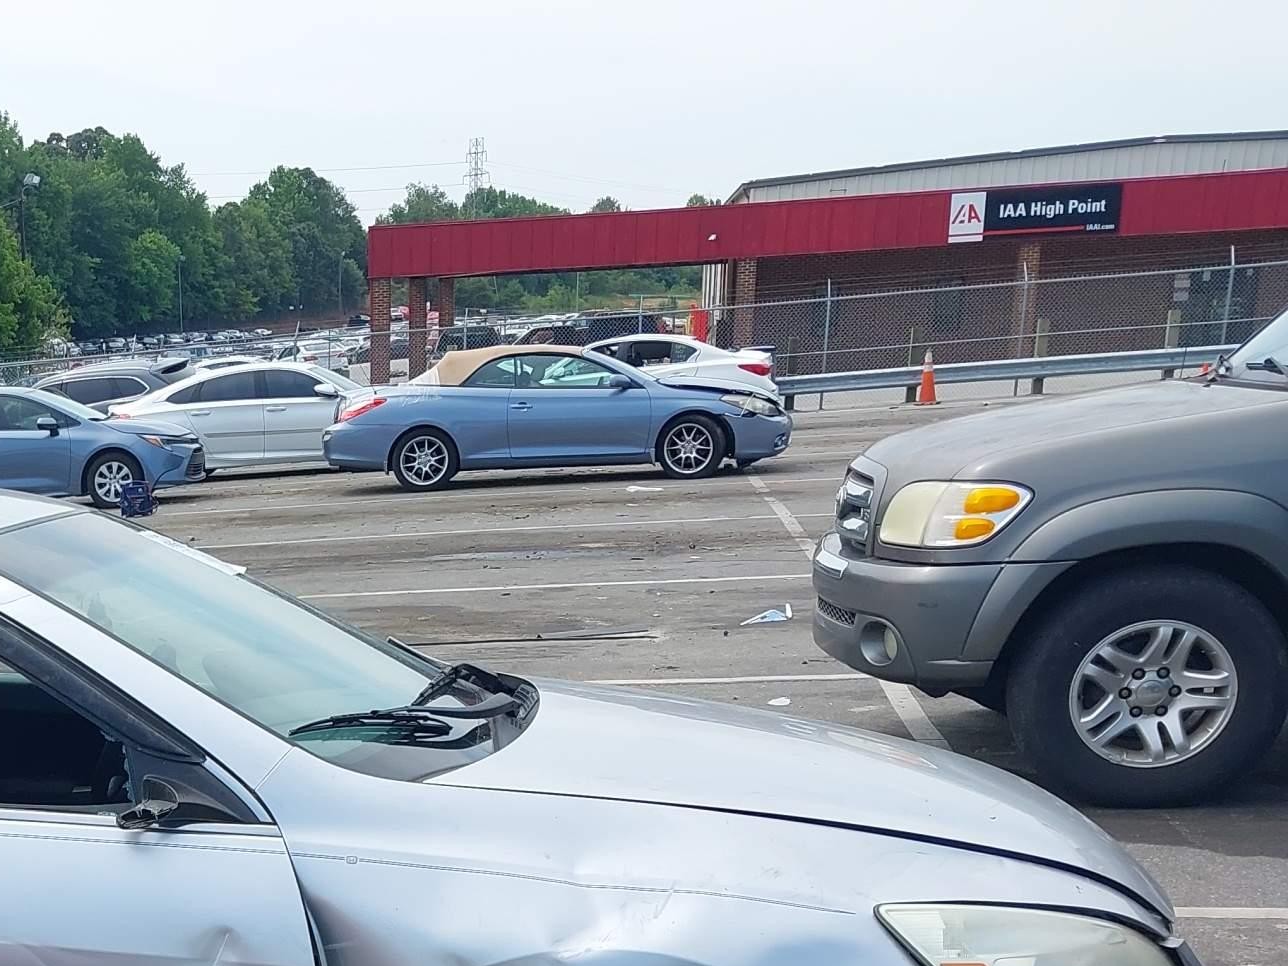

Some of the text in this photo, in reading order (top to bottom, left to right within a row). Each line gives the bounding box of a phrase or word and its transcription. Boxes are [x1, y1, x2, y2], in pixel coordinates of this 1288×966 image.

[999, 199, 1106, 219] IAA High Point
